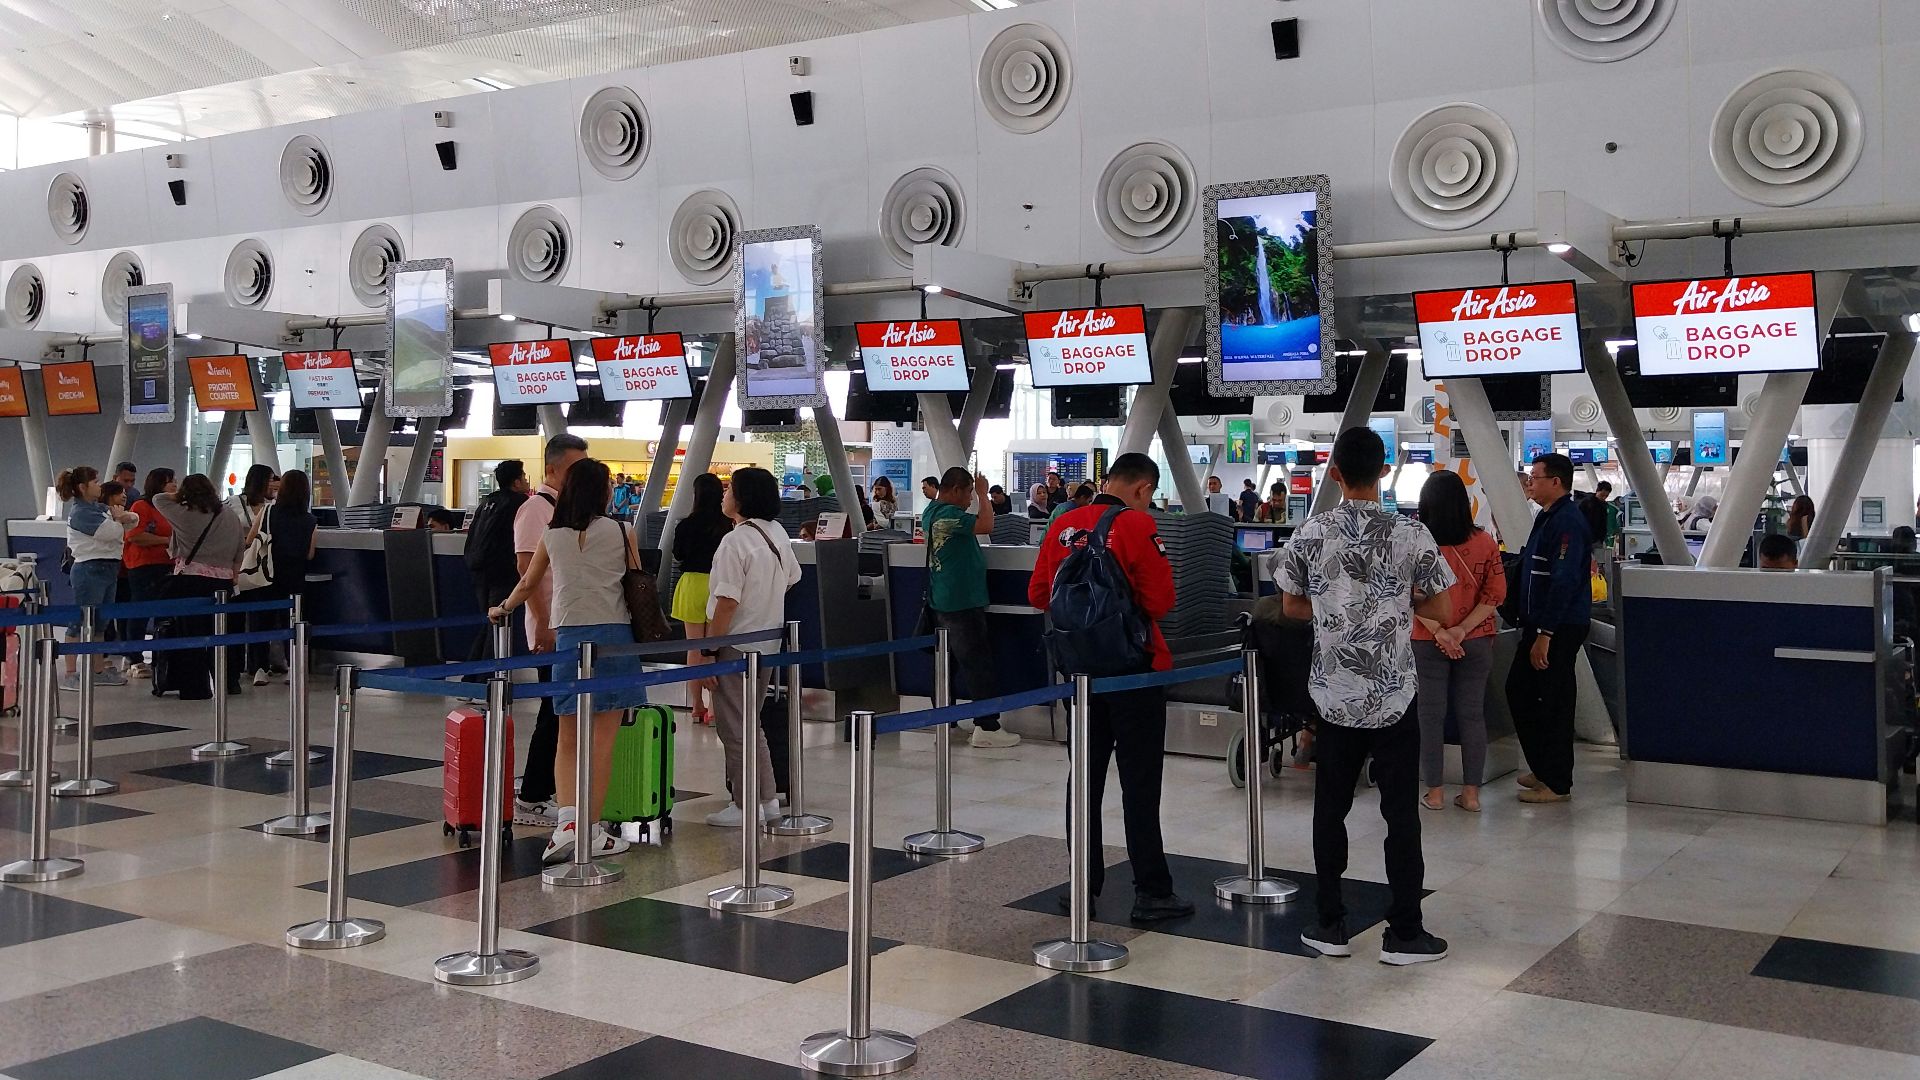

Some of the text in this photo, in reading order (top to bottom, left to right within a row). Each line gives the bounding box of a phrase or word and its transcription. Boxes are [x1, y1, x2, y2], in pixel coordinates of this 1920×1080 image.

[1463, 327, 1562, 345] BAGGAGE
[1686, 322, 1797, 341] BAGGAGE
[1062, 345, 1136, 359] BAGGAGE
[1466, 347, 1521, 362] DROP
[1688, 344, 1751, 360] DROP
[891, 356, 955, 367] BAGGAGE
[622, 366, 679, 378] BAGGAGE
[1064, 362, 1105, 374] DROP
[517, 371, 567, 382] BAGGAGE
[894, 370, 929, 380] DROP
[208, 382, 237, 391] PRIORITY
[520, 385, 547, 394] DROP
[626, 380, 657, 390] DROP
[58, 391, 85, 400] CHECK-IN
[209, 391, 240, 400] COUNTER
